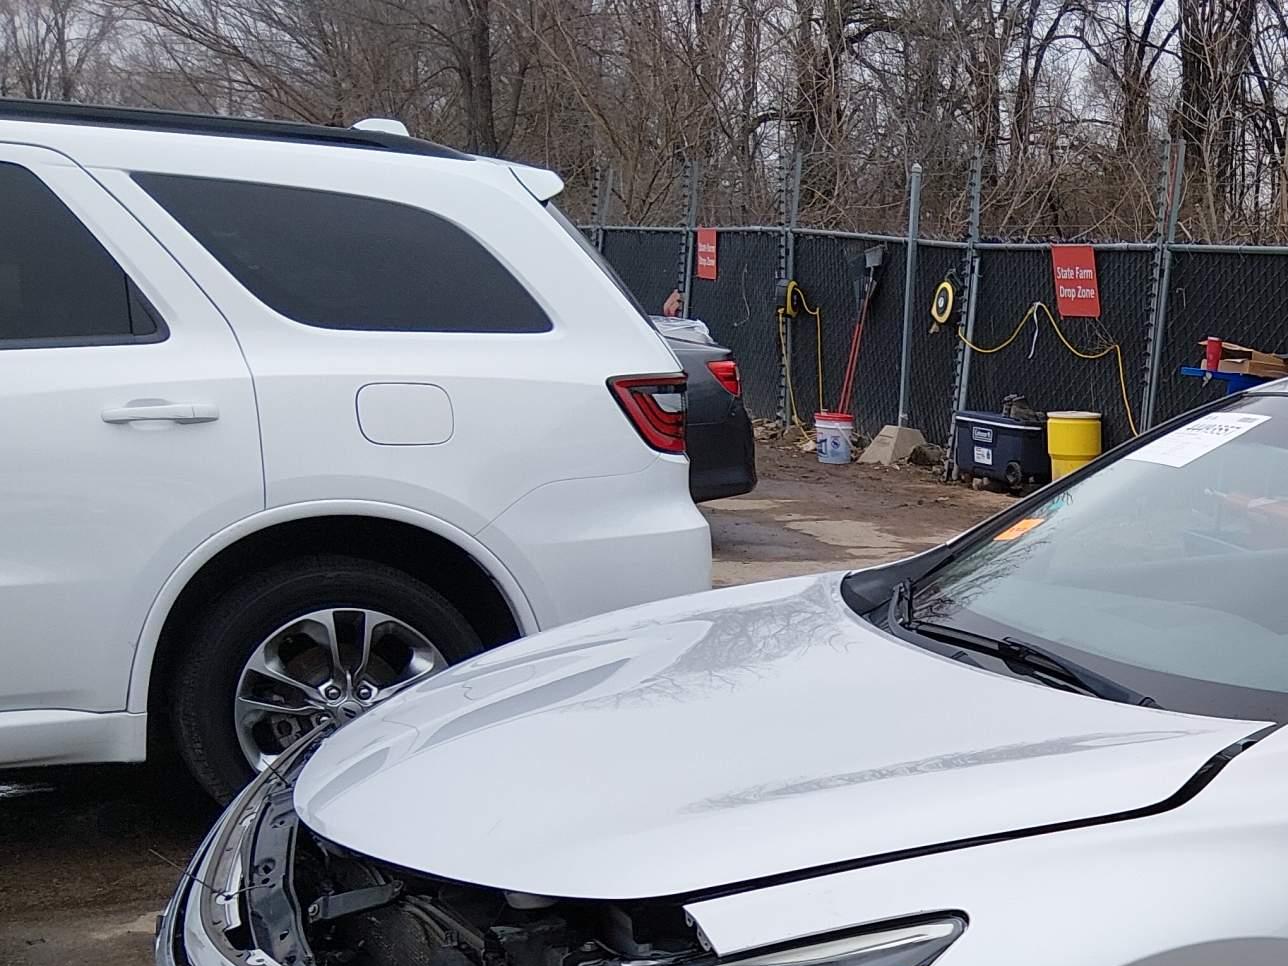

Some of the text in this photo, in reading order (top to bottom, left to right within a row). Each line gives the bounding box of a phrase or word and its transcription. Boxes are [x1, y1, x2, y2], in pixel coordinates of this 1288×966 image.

[1056, 266, 1093, 280] State Farm
[1059, 285, 1095, 301] Drop Zone
